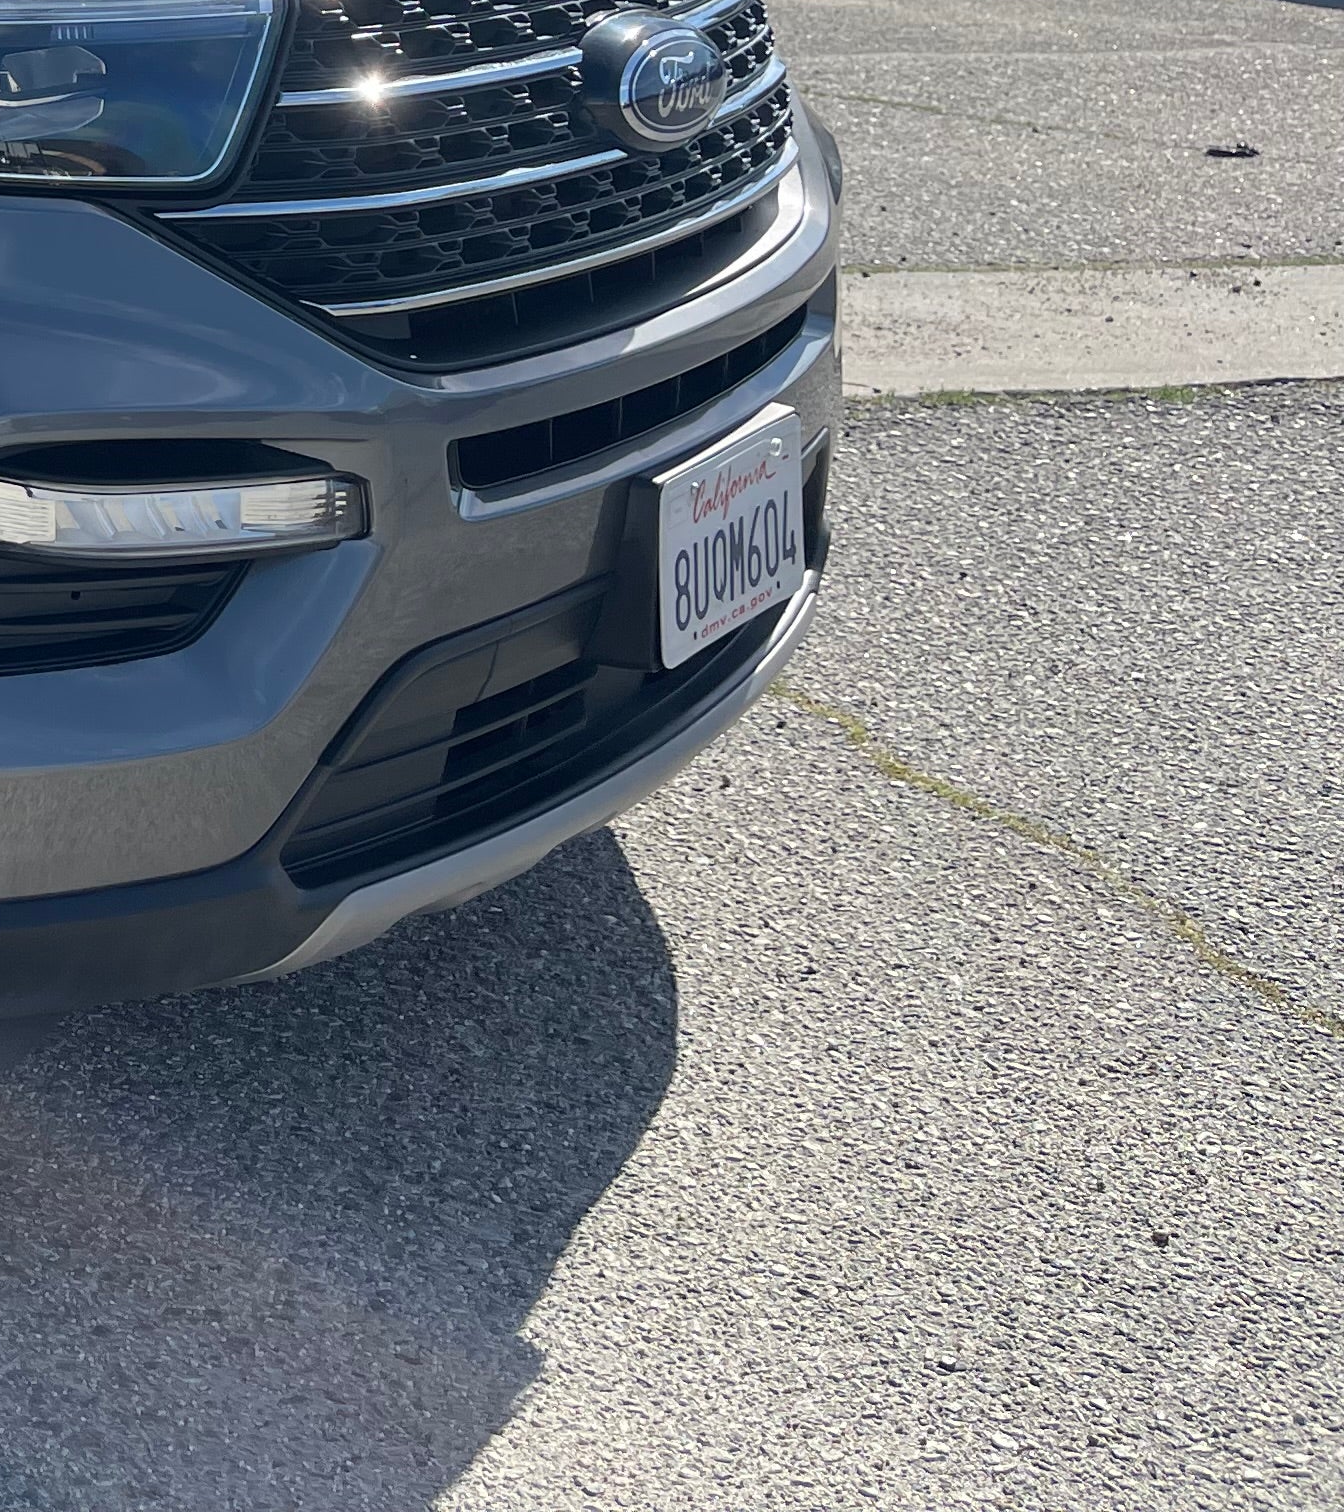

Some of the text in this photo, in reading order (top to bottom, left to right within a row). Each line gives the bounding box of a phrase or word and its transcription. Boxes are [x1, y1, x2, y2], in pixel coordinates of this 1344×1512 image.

[657, 50, 712, 118] Ford
[692, 455, 788, 524] California
[674, 490, 797, 632] 8UQM604
[699, 586, 774, 640] dmv.ca.gov
